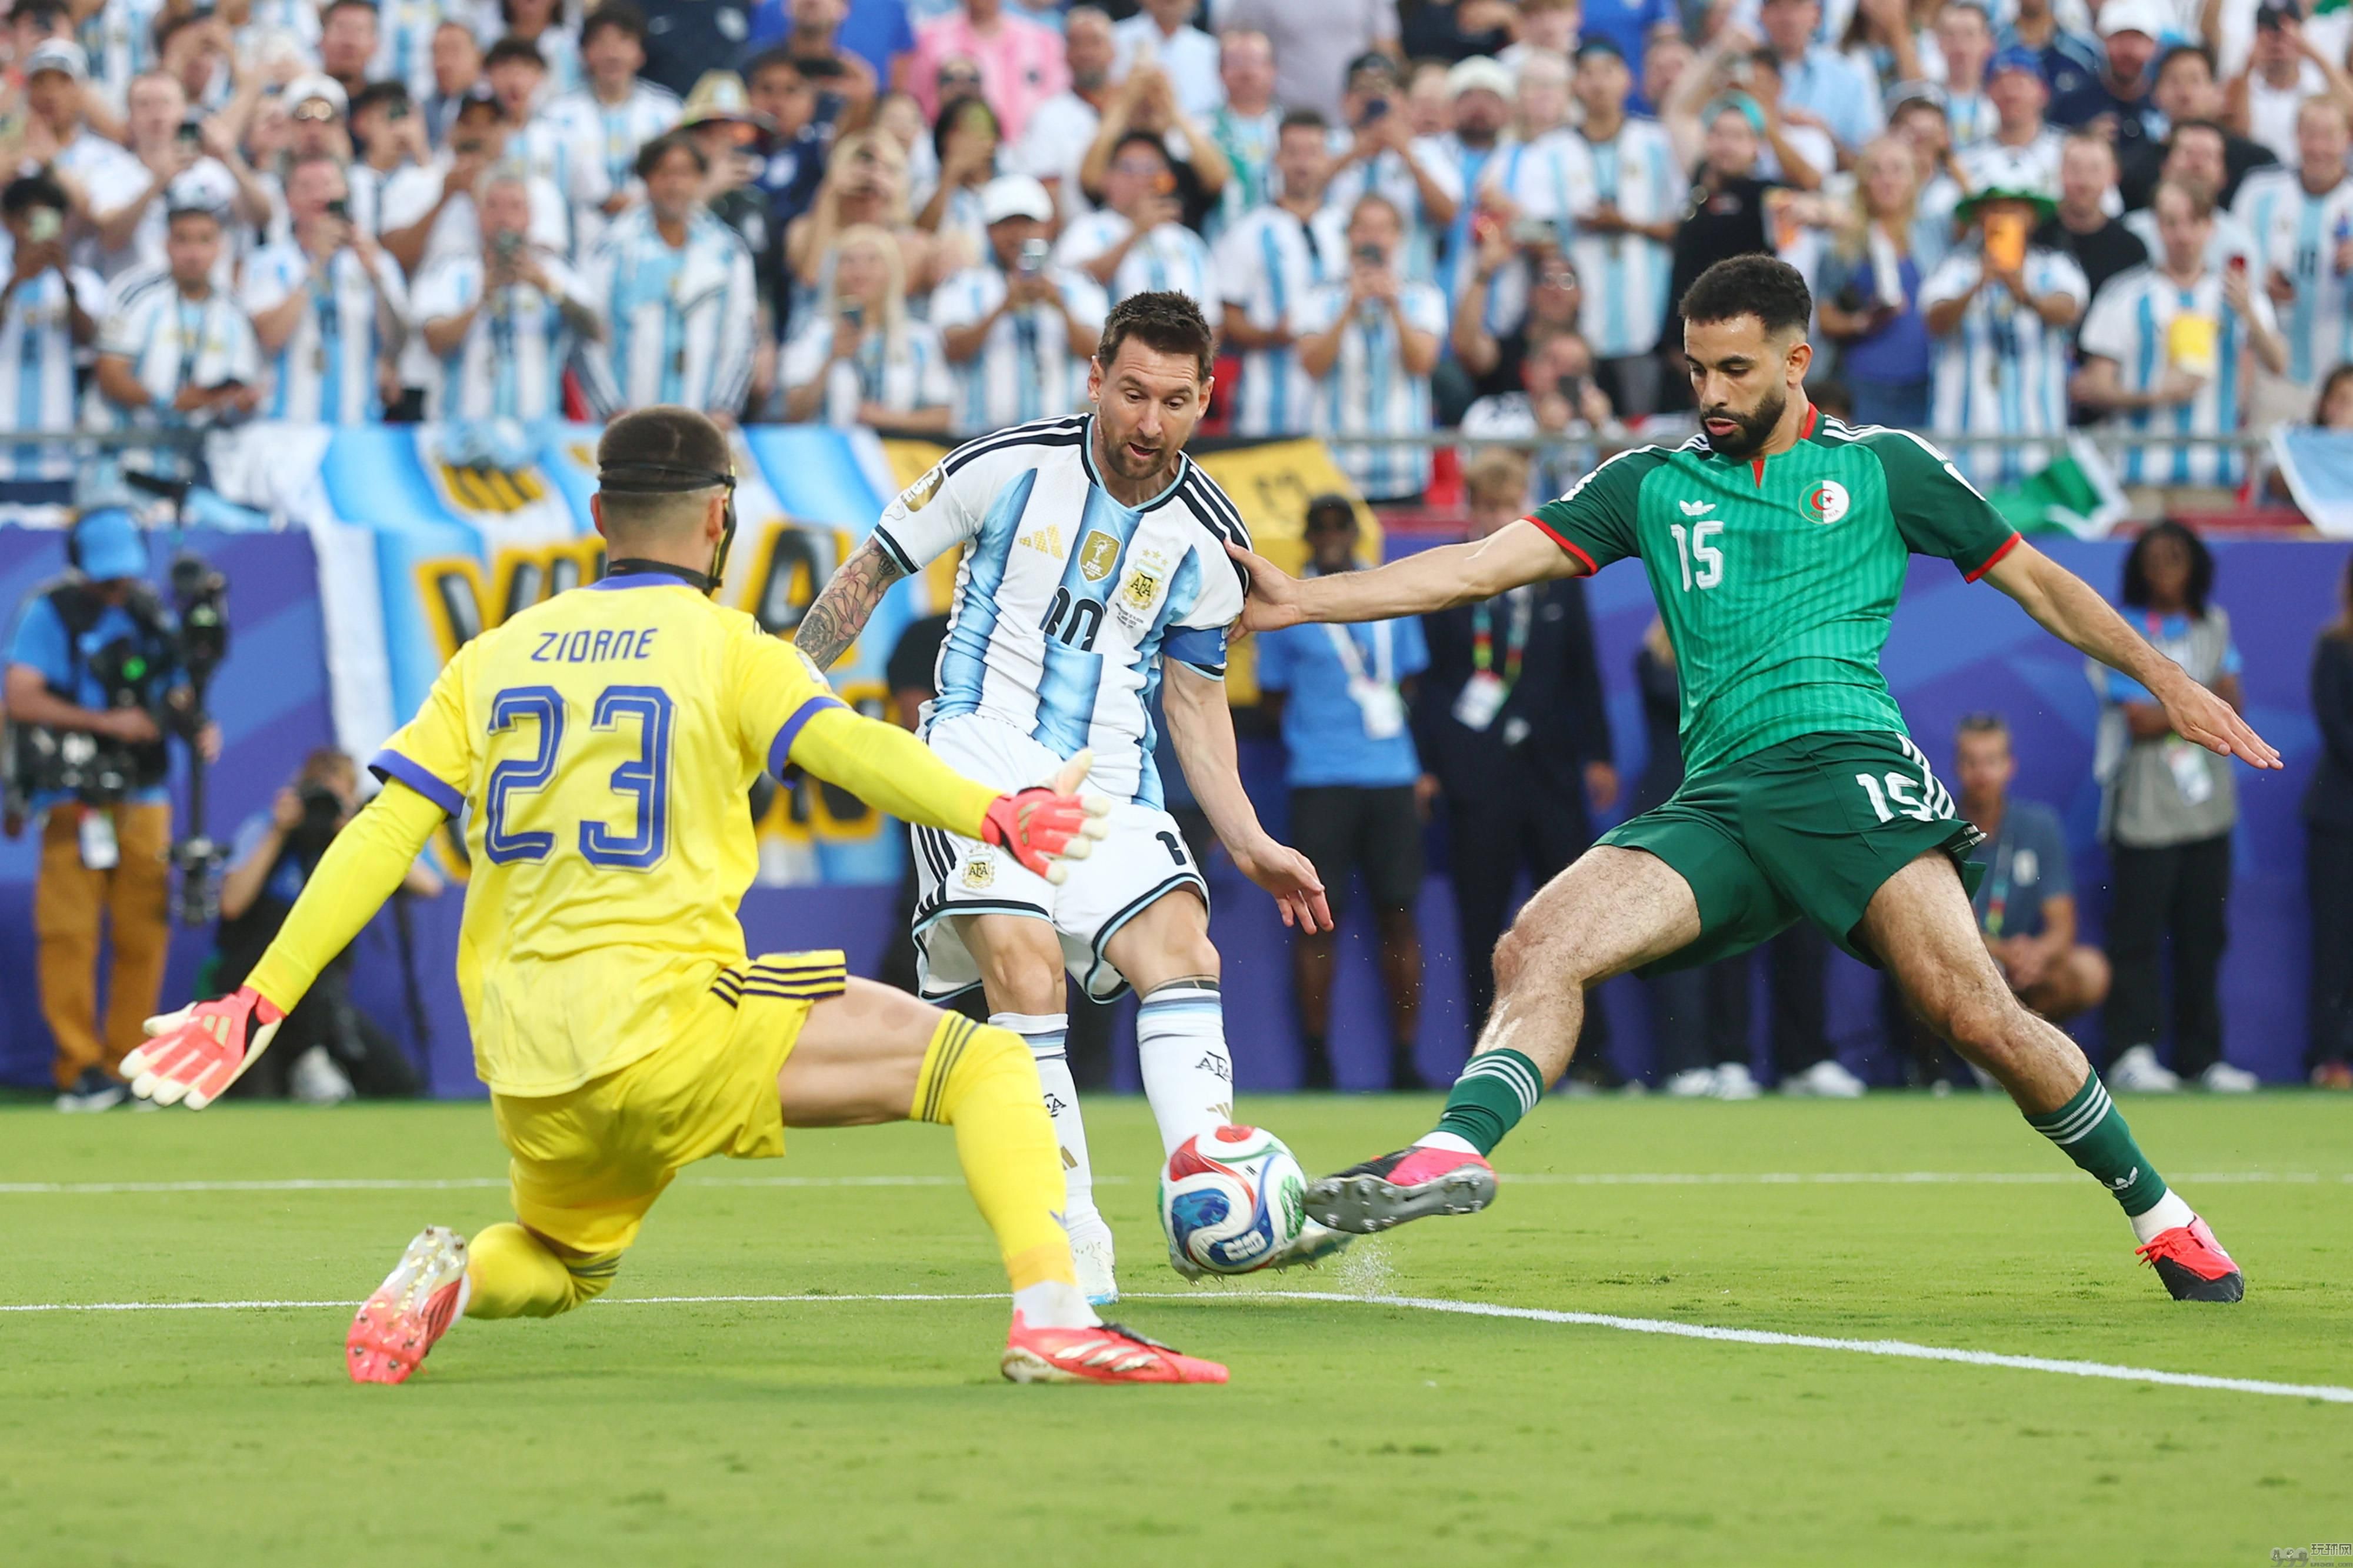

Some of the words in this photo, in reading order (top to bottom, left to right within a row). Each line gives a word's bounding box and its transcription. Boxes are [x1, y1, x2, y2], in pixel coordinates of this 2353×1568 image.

[1130, 573, 1154, 597] AFA
[1671, 521, 1724, 592] 15
[1044, 586, 1104, 652] 10
[486, 685, 677, 873] 23
[1855, 772, 1934, 823] 15
[969, 862, 988, 878] AFA
